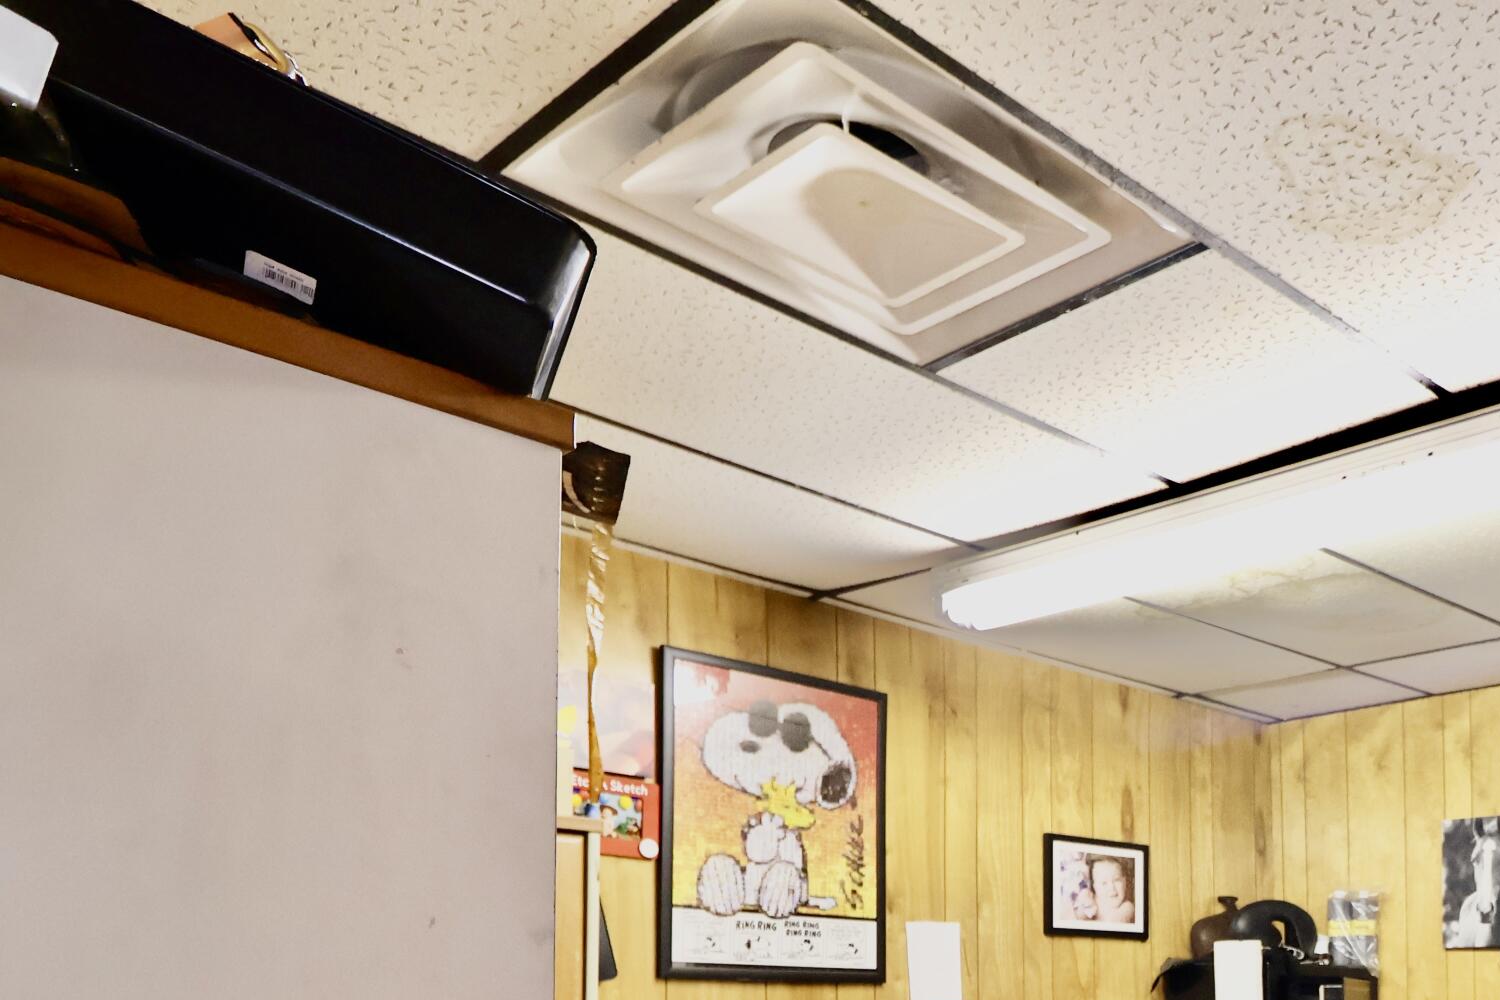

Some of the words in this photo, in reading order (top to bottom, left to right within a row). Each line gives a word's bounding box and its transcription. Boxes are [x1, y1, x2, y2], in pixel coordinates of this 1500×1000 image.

[610, 779, 649, 797] Sketch
[735, 920, 755, 930] RING
[757, 921, 777, 931] RING
[803, 921, 820, 929] RING
